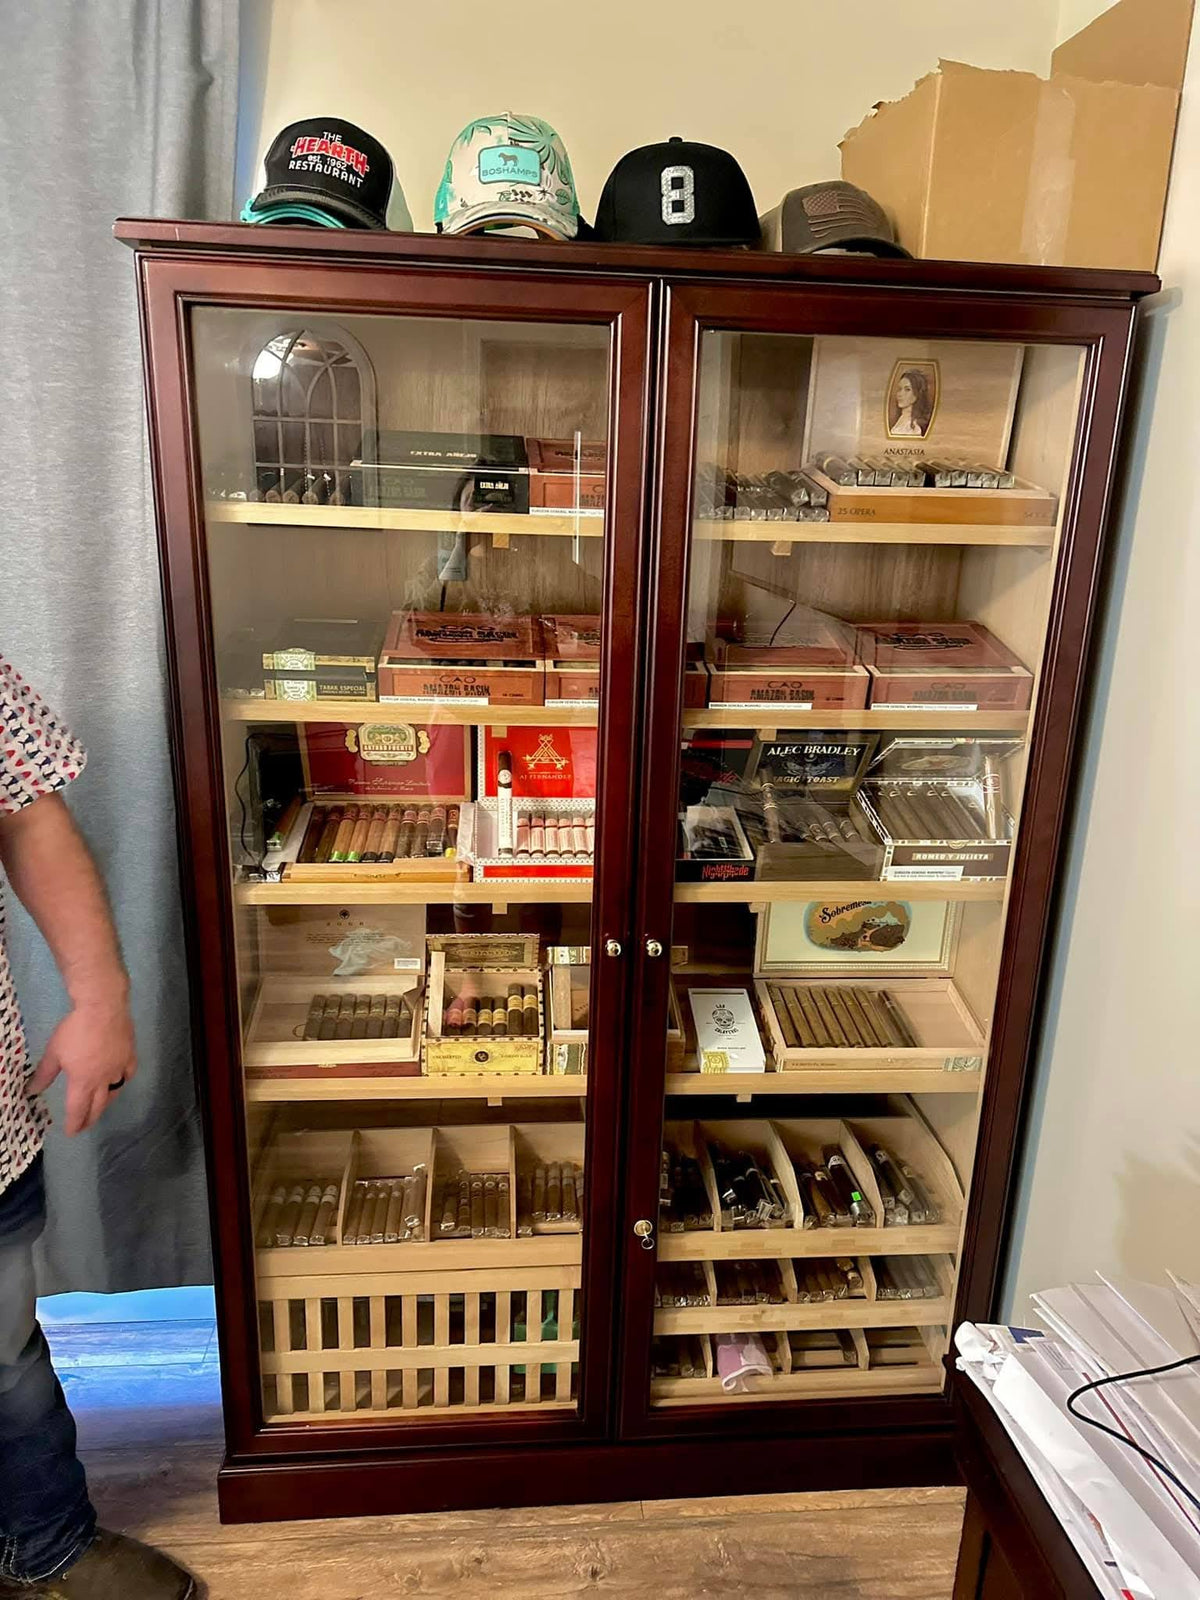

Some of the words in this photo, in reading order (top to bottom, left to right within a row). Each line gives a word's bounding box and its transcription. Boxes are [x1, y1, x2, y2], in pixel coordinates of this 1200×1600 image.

[323, 131, 343, 143] THE
[290, 136, 370, 178] HEARTH
[326, 157, 348, 171] 1962
[288, 160, 363, 188] RESTAURANT
[482, 167, 538, 178] BOSHAMPS
[660, 165, 695, 226] 8
[884, 448, 926, 456] ANASTASIA
[837, 508, 848, 516] 25
[849, 508, 877, 517] OPERA
[439, 674, 477, 684] CAO
[767, 680, 803, 689] CAO
[767, 747, 801, 758] ALEC
[804, 745, 861, 756] BRADLEY
[807, 776, 840, 784] TOAST
